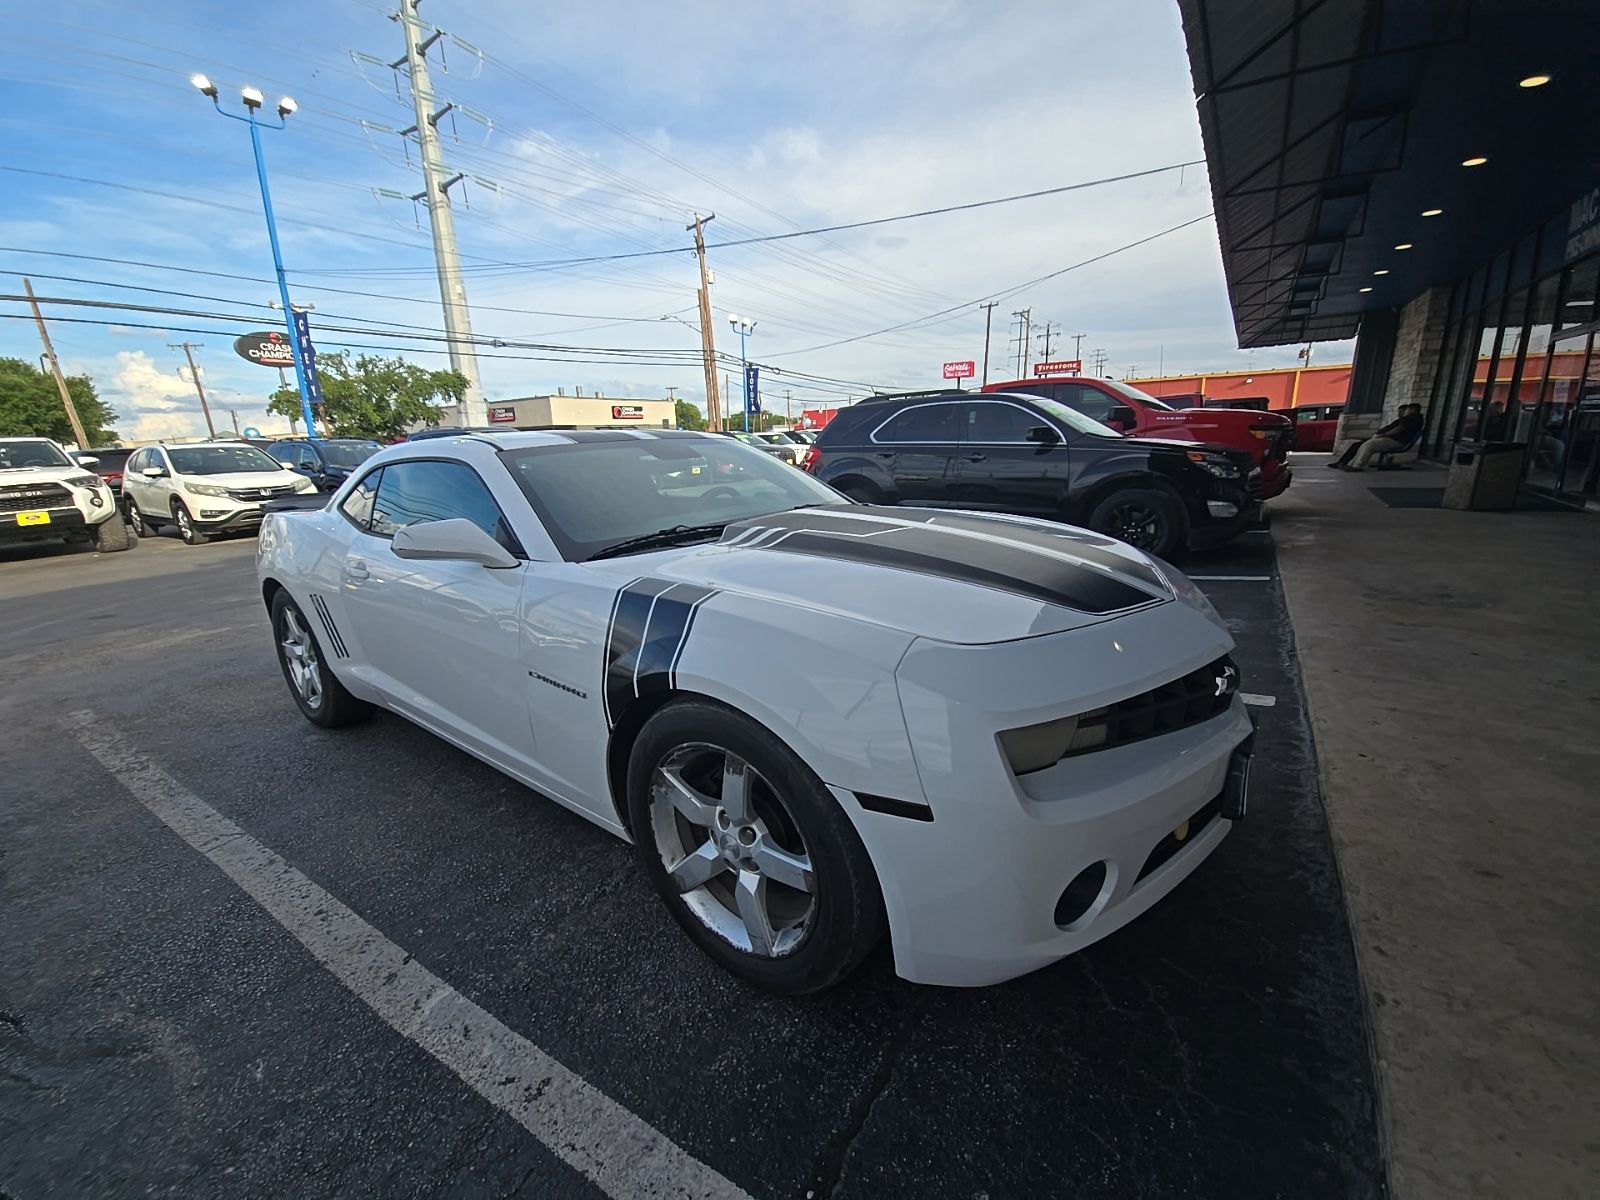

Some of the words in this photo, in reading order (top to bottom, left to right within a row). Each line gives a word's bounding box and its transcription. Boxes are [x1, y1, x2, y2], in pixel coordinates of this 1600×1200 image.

[260, 343, 292, 352] CRASH
[249, 350, 294, 359] CHAMPIO
[299, 319, 317, 397] CHEVY
[1038, 363, 1078, 372] Firestone
